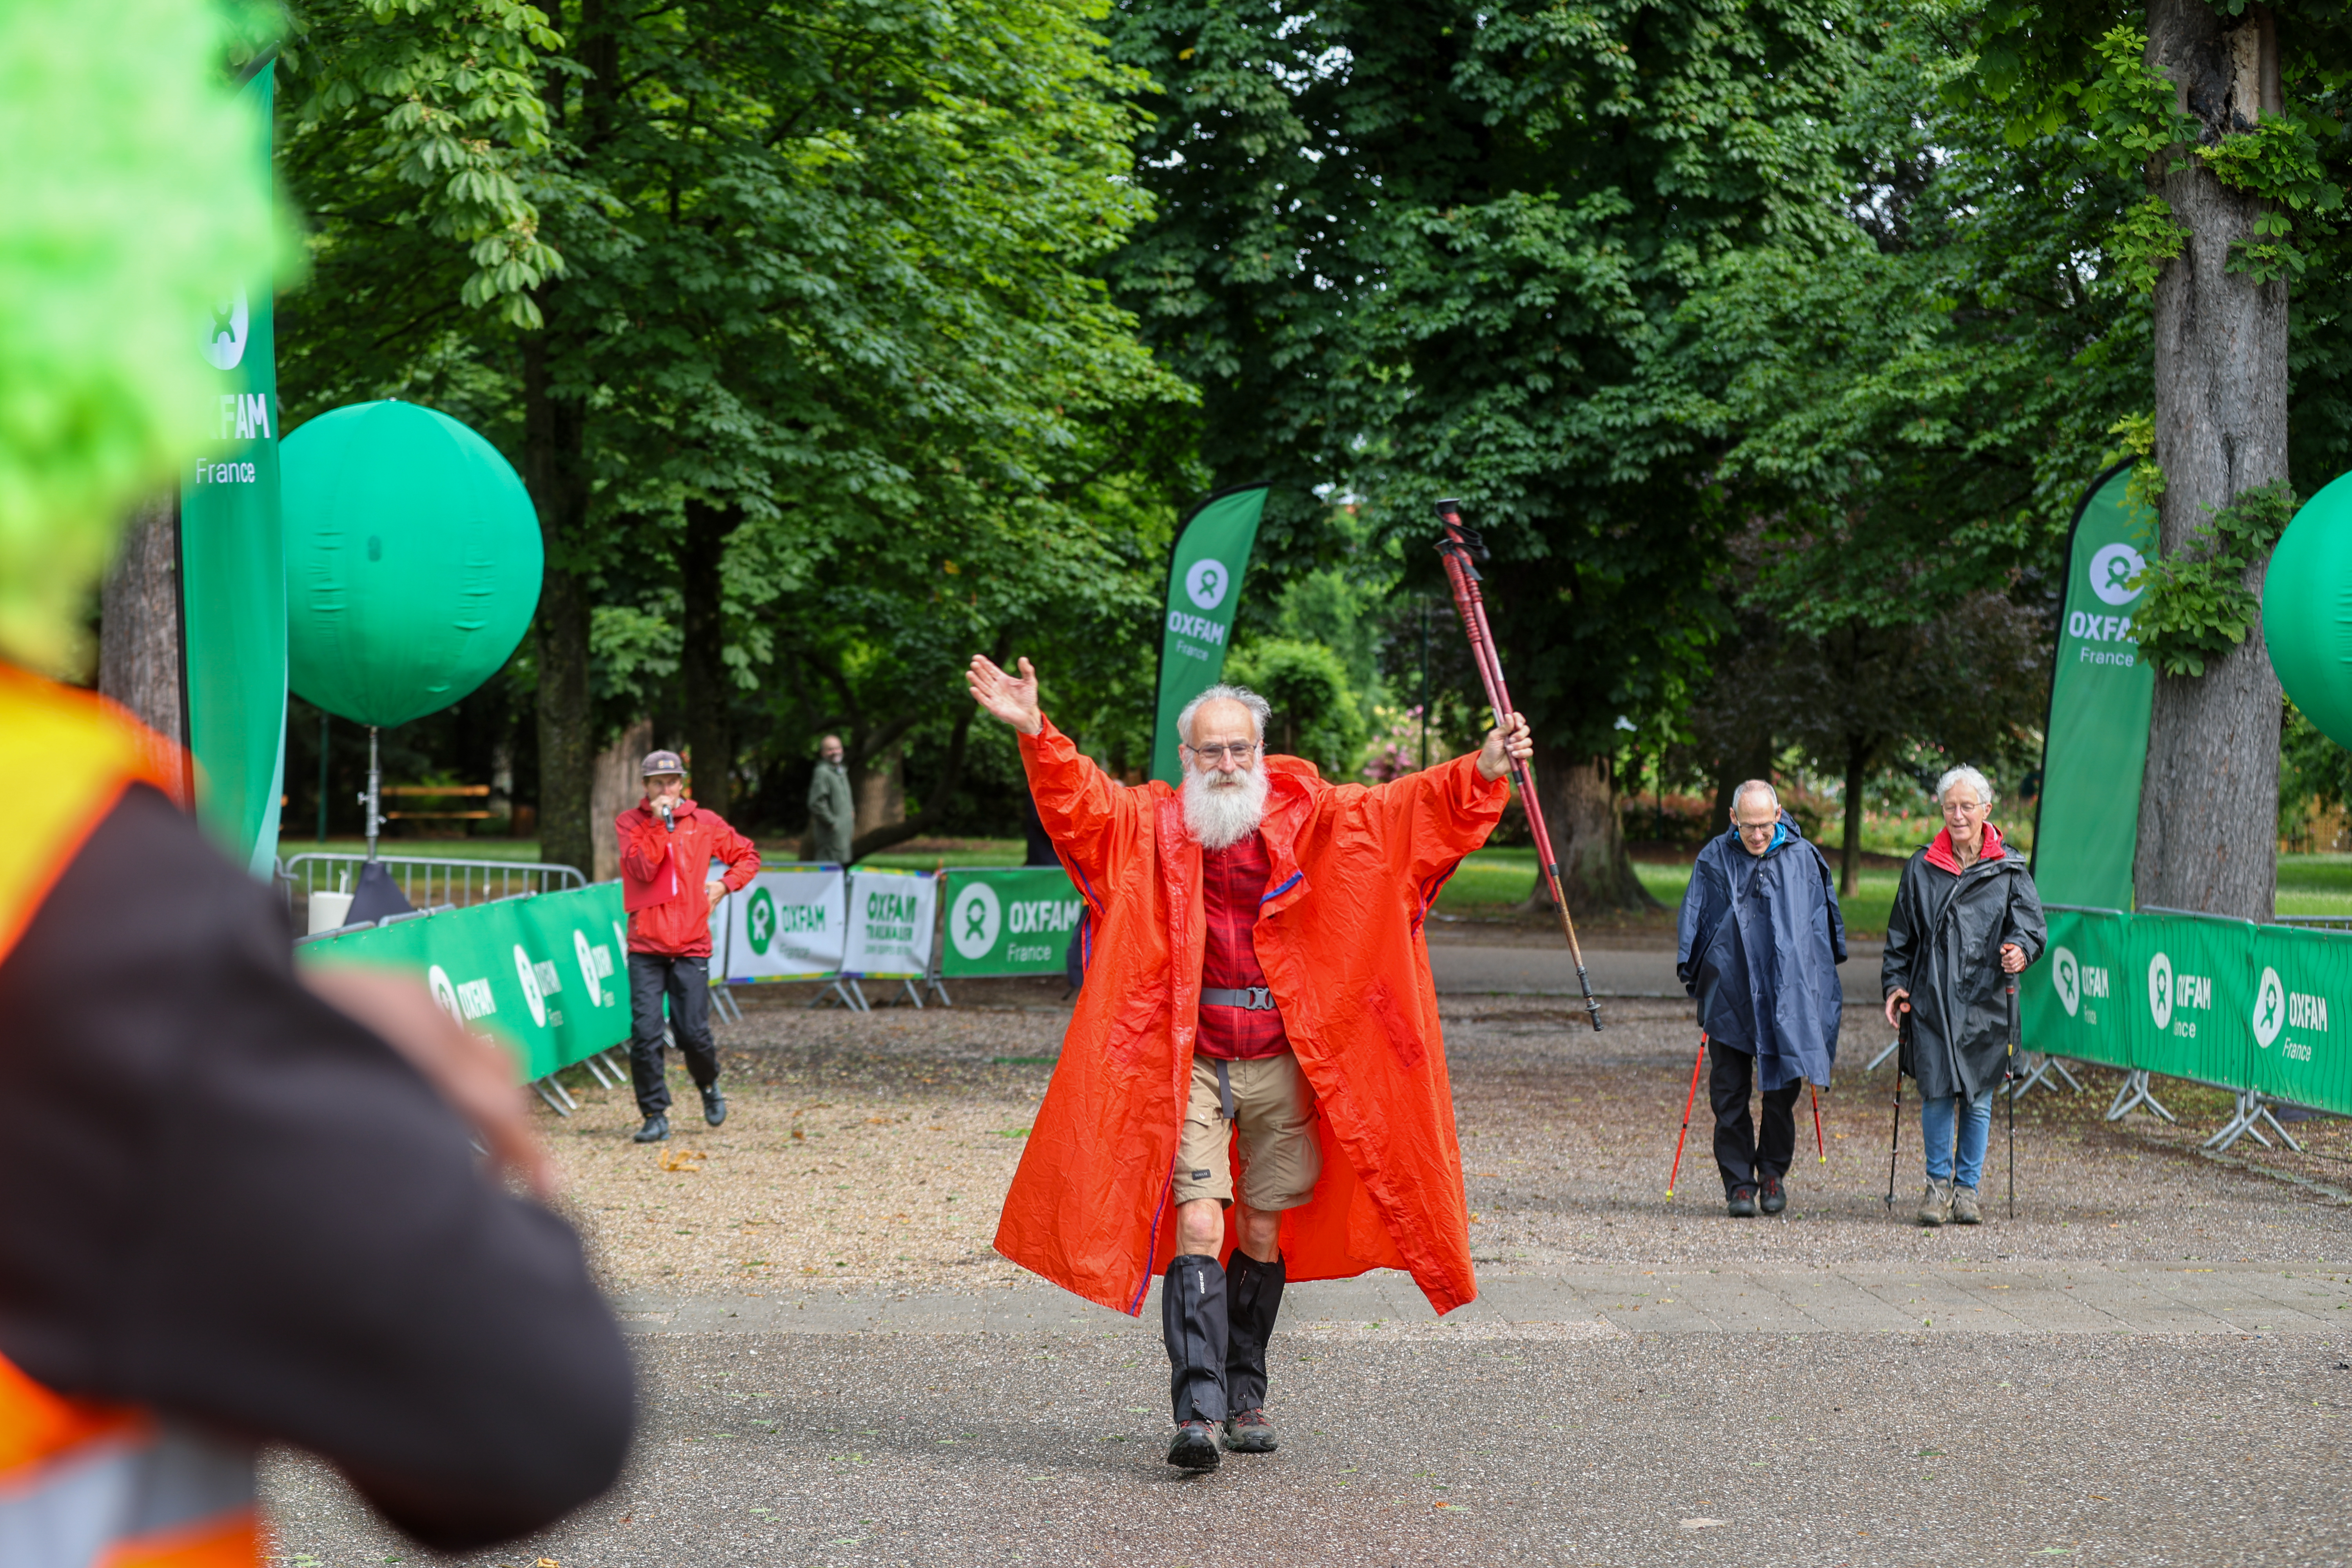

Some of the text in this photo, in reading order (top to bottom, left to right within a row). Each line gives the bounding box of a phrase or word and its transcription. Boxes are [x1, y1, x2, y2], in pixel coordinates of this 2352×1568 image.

[209, 393, 270, 439] FAM
[196, 457, 256, 484] France
[1168, 610, 1225, 646] OXFAM
[2069, 611, 2141, 644] OXFA
[1176, 639, 1209, 662] France
[2080, 646, 2134, 668] France
[782, 905, 826, 933] OXFAM
[1009, 900, 1081, 934] OXFAM
[1007, 942, 1052, 962] France
[2082, 965, 2109, 998] OXFAM
[2176, 974, 2212, 1010] OXFAM
[2289, 991, 2328, 1033] OXFAM
[2282, 1036, 2312, 1062] France
